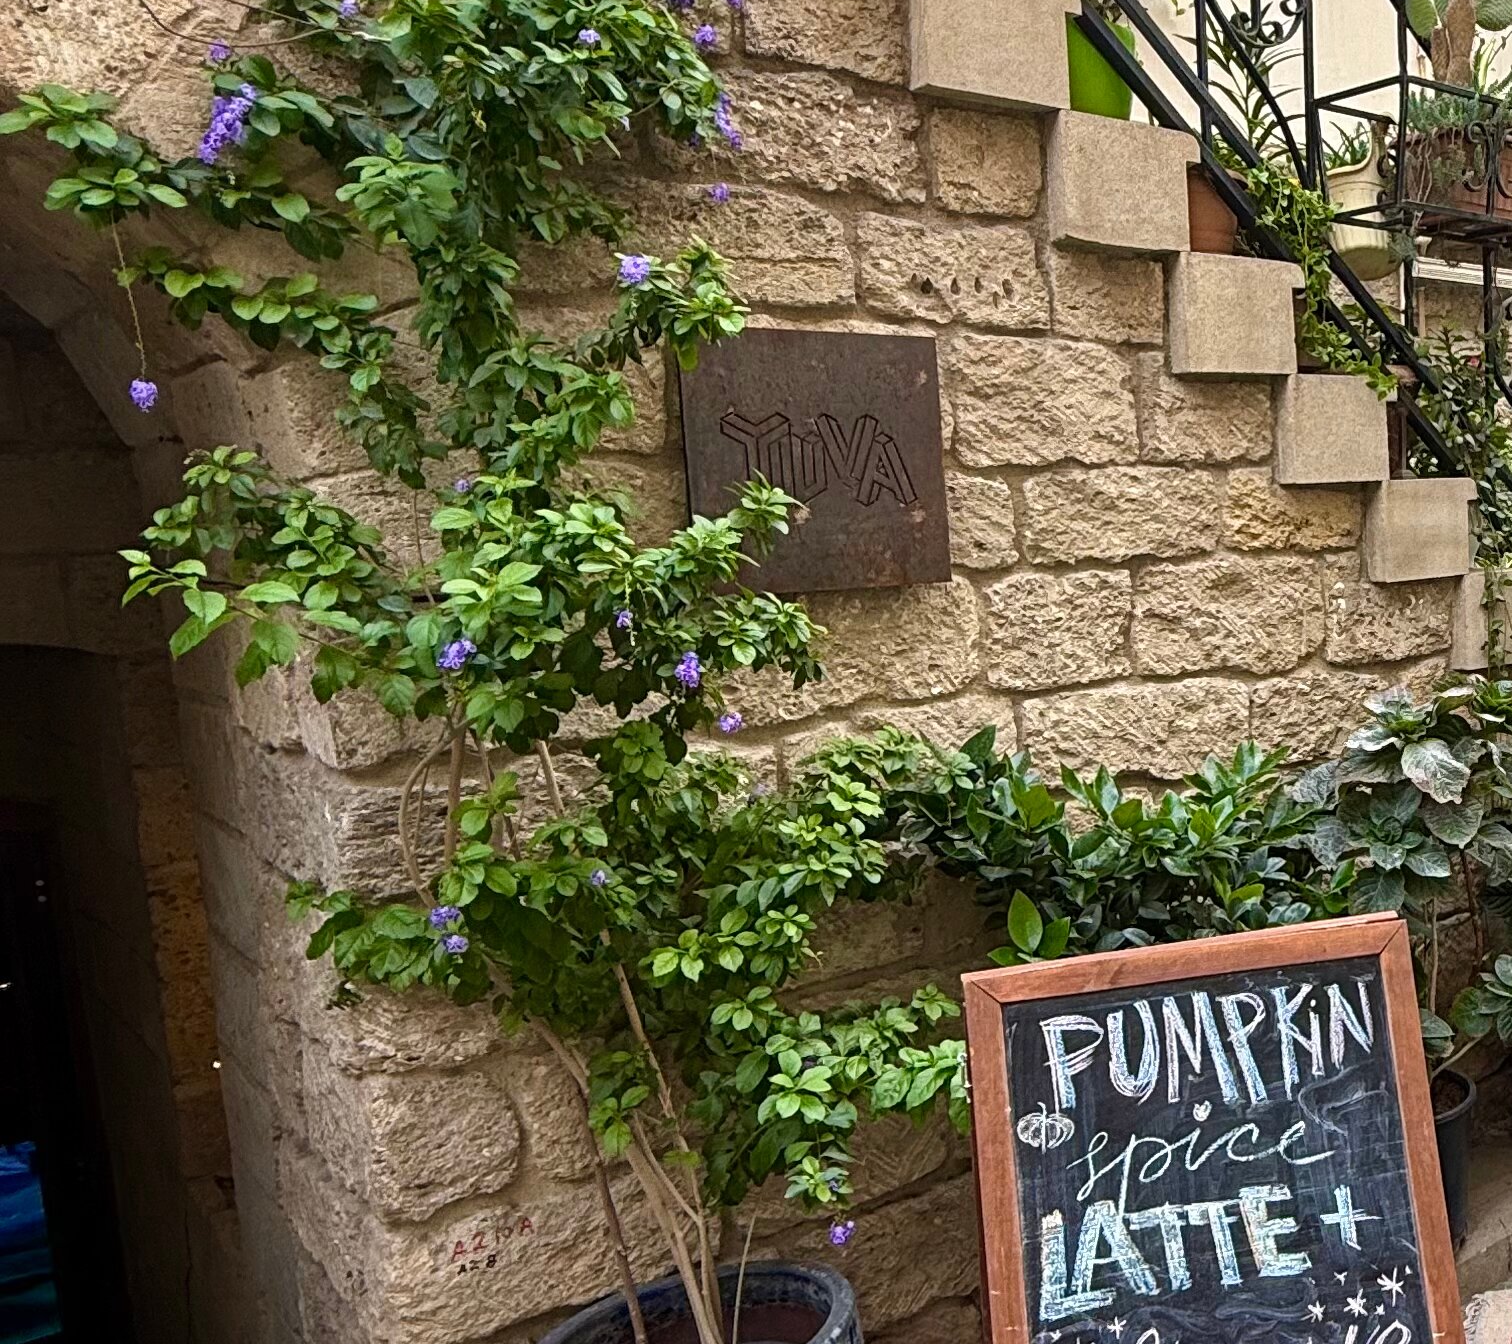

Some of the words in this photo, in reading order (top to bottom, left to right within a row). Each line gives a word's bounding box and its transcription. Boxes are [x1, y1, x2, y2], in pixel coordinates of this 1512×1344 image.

[1066, 1101, 1336, 1216] spice
[1038, 1184, 1312, 1322] LATTE
[1320, 1184, 1382, 1250] +
